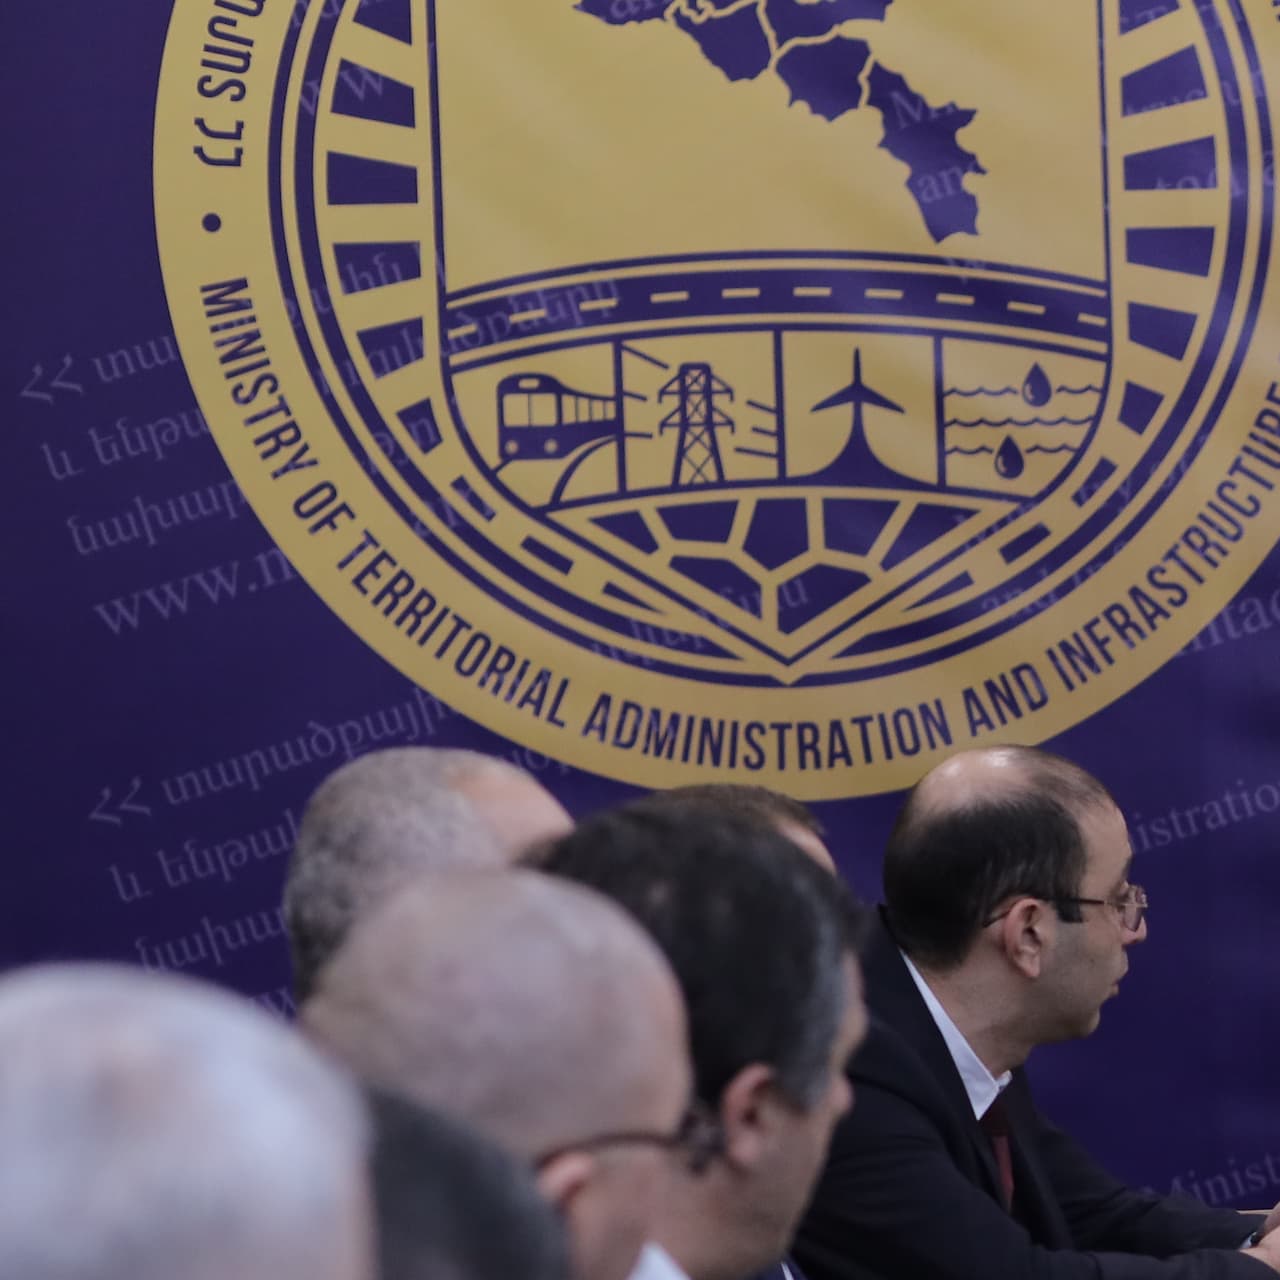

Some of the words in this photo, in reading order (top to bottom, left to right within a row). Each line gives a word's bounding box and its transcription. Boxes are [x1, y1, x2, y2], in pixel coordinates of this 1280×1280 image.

[198, 275, 321, 481] MINISTRY
[291, 478, 357, 538] OF
[336, 528, 572, 729] TERRITORIAL
[580, 691, 953, 773] ADMINISTRATION
[961, 662, 1050, 738] AND
